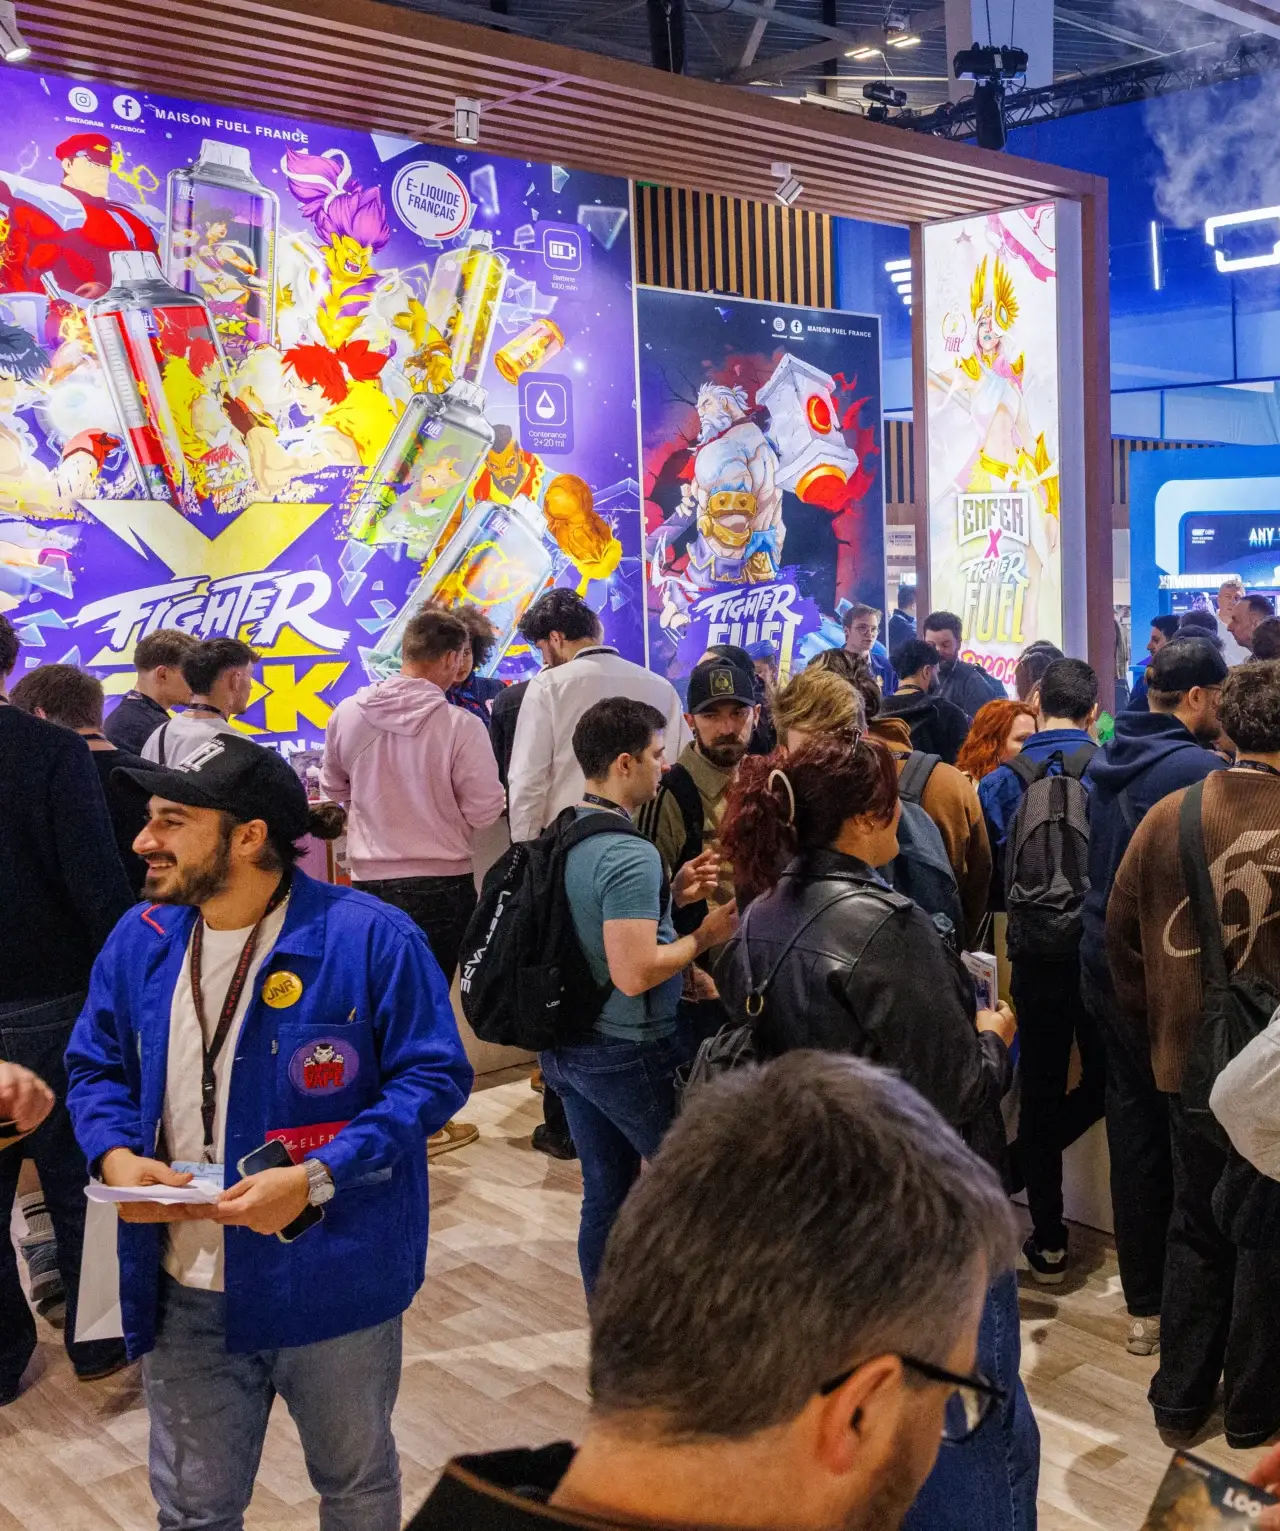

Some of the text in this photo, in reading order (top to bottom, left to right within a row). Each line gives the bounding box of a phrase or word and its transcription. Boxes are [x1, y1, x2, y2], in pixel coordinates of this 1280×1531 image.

[65, 116, 104, 128] INSTAGRAM
[111, 124, 146, 134] FACEBOOK
[155, 109, 309, 144] MAISON FUEL FRANCE
[407, 194, 456, 221] FRANÇAIS
[419, 182, 461, 208] LIQUIDE
[807, 326, 831, 334] MAISON
[848, 330, 872, 338] FRANCE
[945, 336, 961, 353] FUEL
[528, 430, 567, 439] Contenance
[533, 438, 565, 447] 2+20 ml
[984, 528, 1002, 559] X
[1249, 527, 1274, 543] ANY
[960, 552, 1030, 584] FIGHTER
[63, 570, 350, 650] FIGHTER
[692, 584, 804, 623] FIGHTER
[962, 577, 1029, 643] FUEL
[460, 946, 488, 995] VAPE
[267, 979, 296, 1001] JNR
